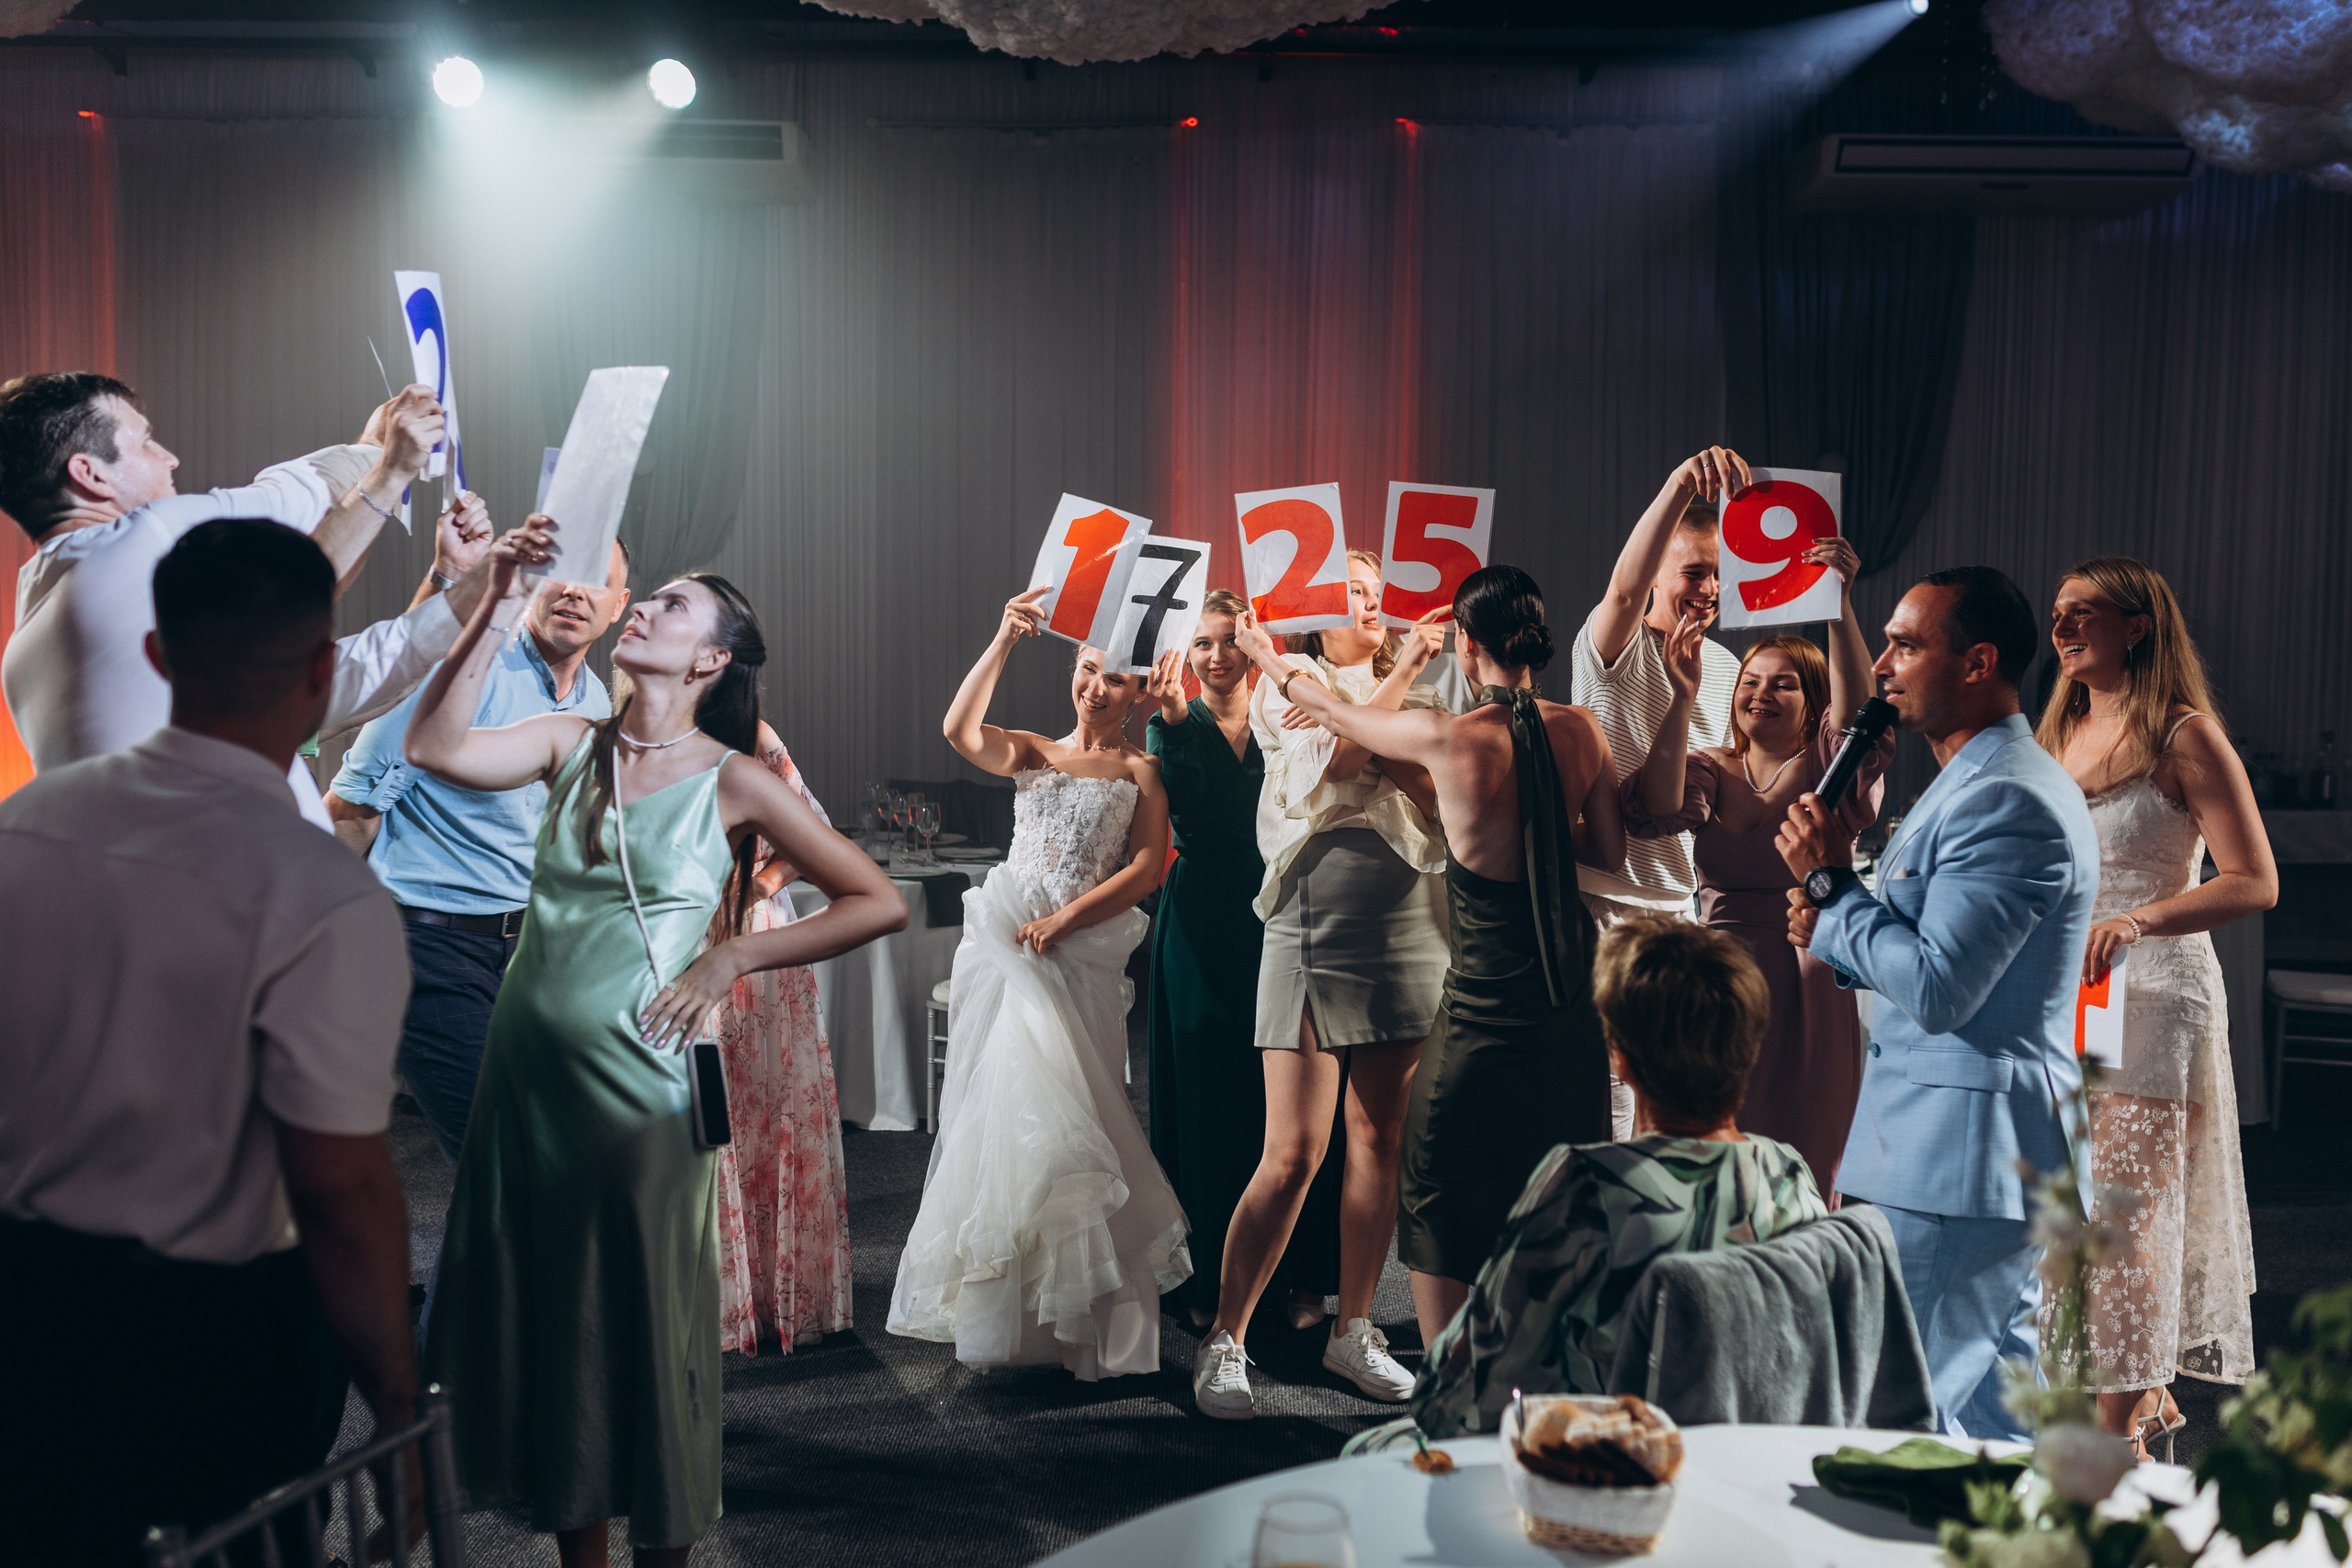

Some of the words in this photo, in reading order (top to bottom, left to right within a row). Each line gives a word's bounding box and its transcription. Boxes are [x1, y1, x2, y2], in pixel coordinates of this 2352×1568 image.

[1049, 508, 1130, 641] 1
[1131, 544, 1202, 668] 7
[1241, 499, 1349, 624] 2
[1381, 491, 1482, 623] 5
[1722, 480, 1838, 611] 9
